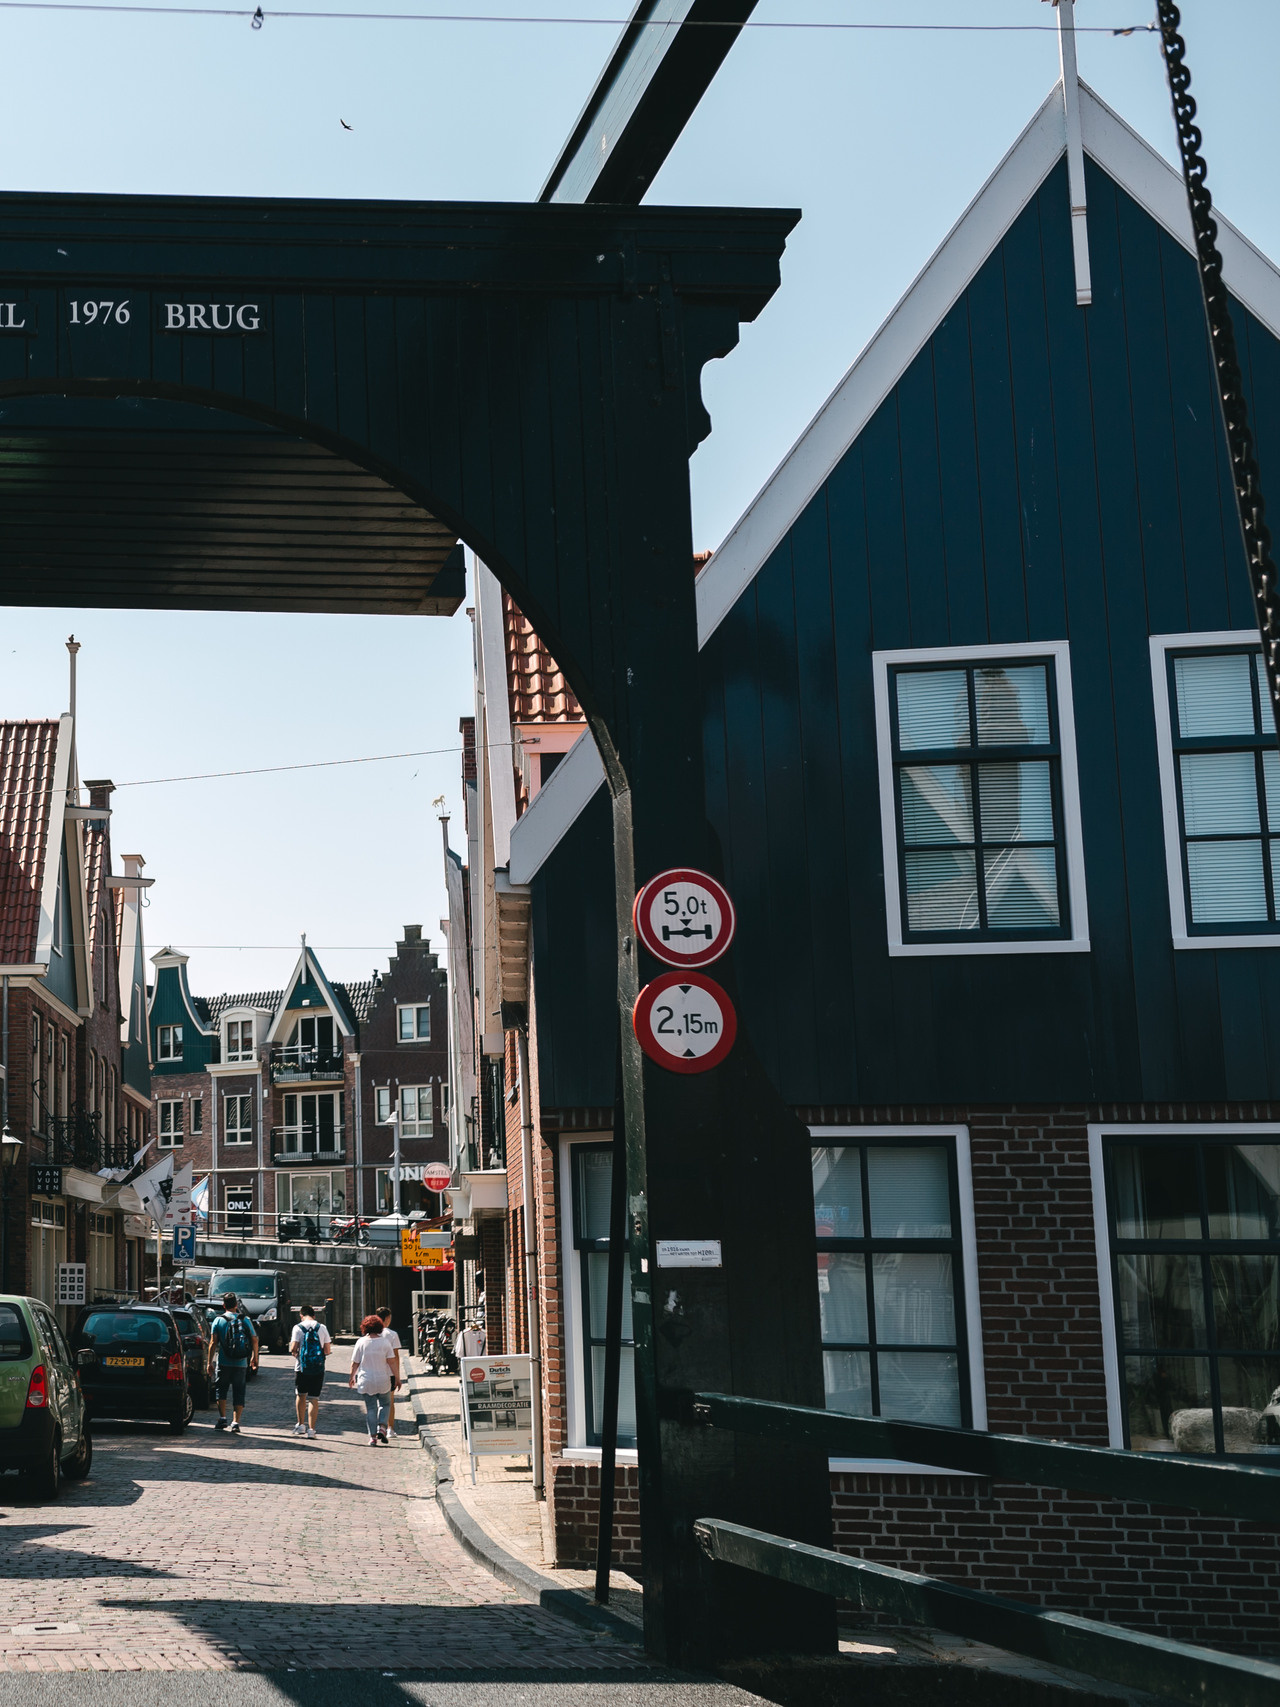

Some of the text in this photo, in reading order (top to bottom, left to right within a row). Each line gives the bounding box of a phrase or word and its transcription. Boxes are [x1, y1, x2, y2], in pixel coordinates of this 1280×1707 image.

[69, 300, 130, 325] 1976
[165, 303, 261, 330] BRUG
[227, 1201, 253, 1210] ONLY
[178, 1228, 190, 1245] P
[109, 1357, 142, 1365] 72-SV-PJ
[477, 1401, 529, 1409] RAAMDECORATIE
